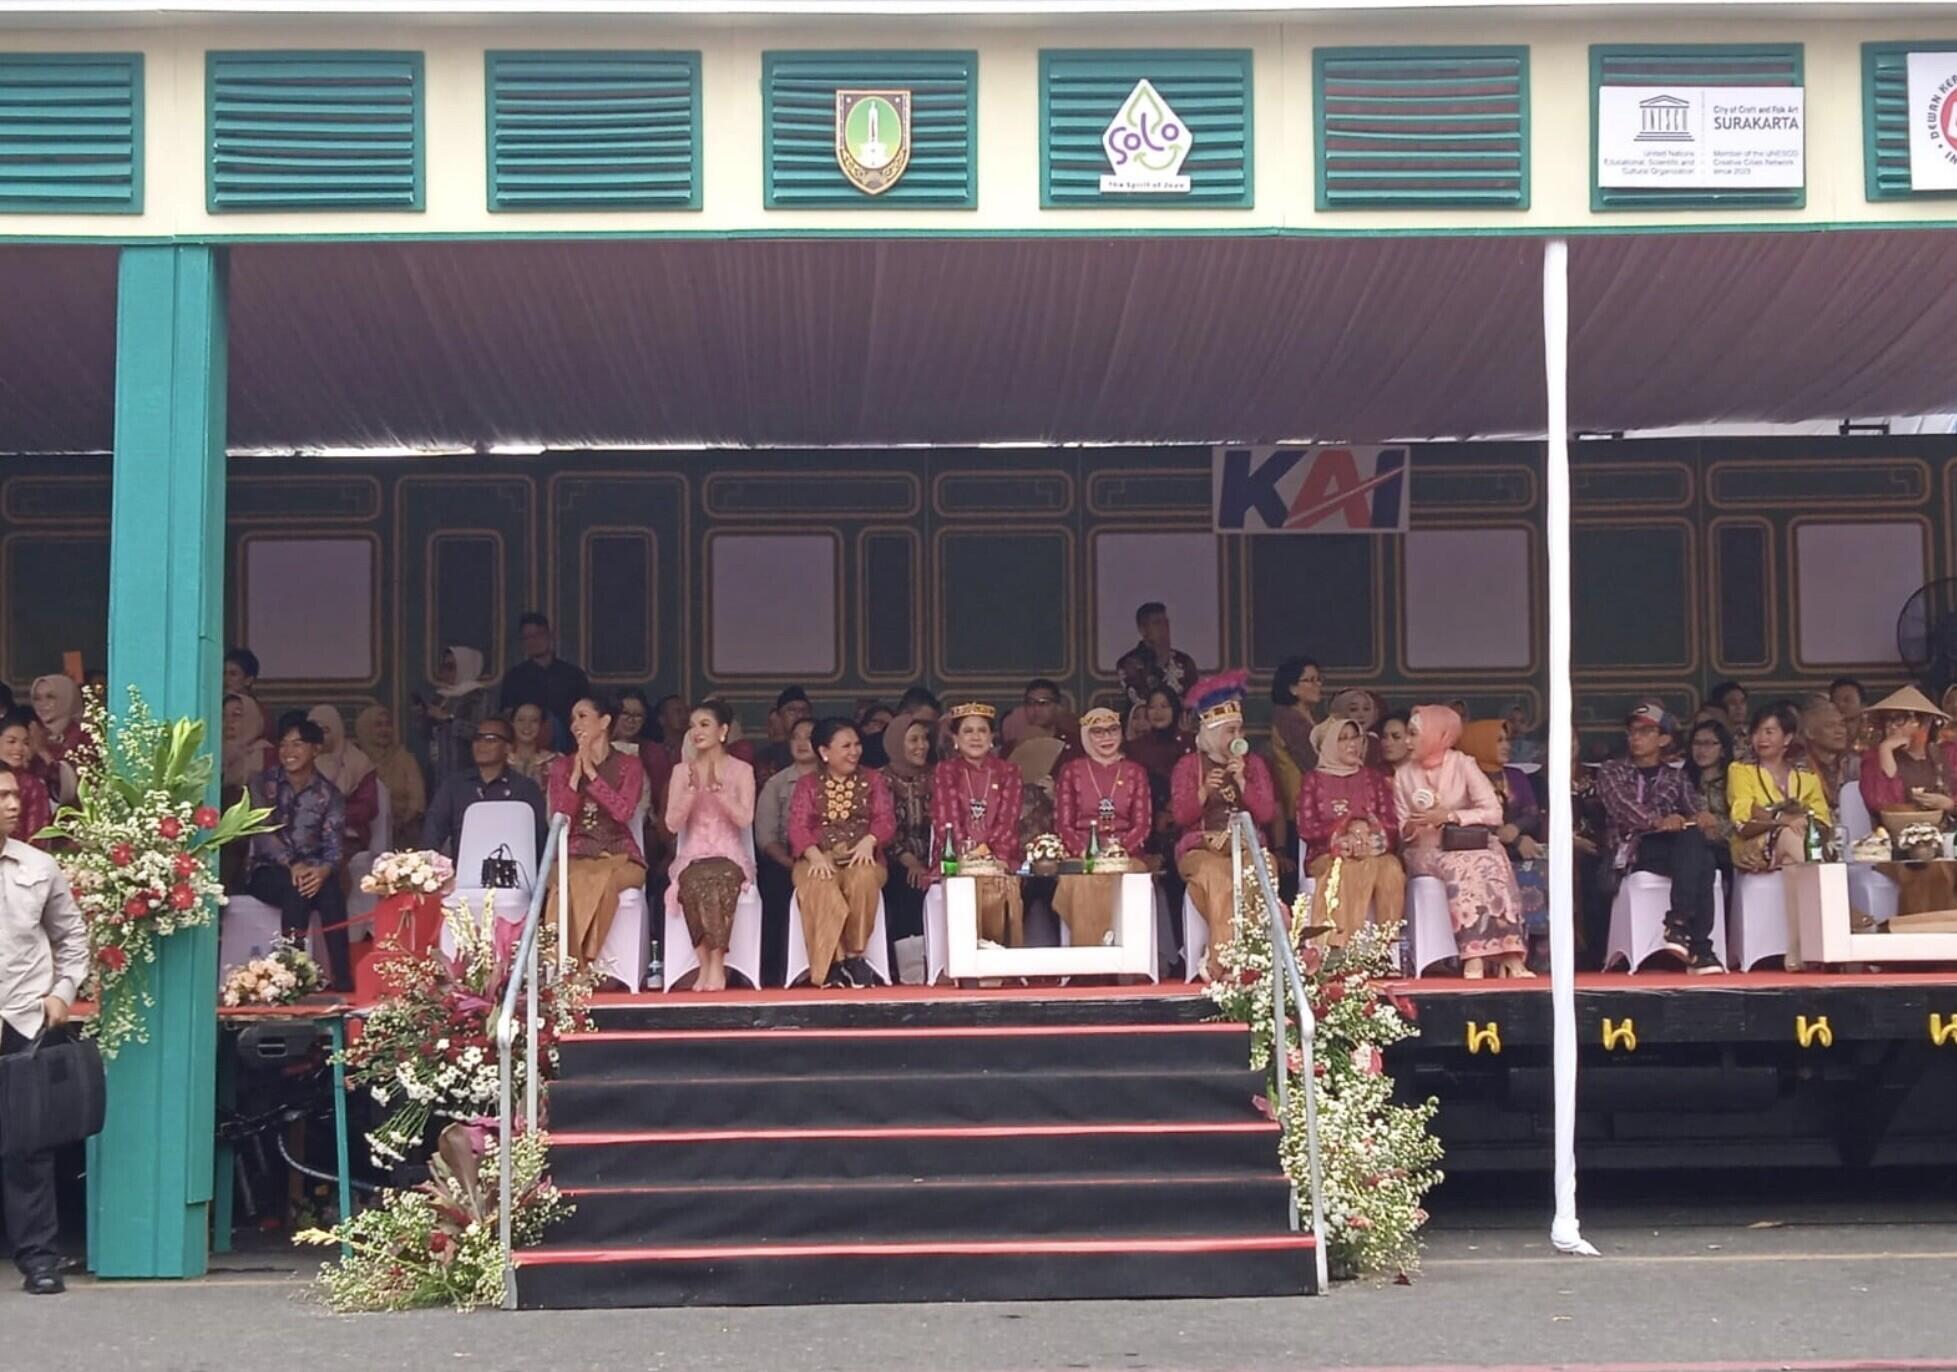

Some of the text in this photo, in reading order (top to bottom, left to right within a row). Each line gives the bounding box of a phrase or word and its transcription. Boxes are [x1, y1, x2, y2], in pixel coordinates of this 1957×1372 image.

[1713, 105, 1799, 115] City of Craft and Folk Art
[1714, 116, 1799, 130] SURAKARTA
[1927, 94, 1941, 140] DEWAN
[1219, 449, 1406, 529] KAI
